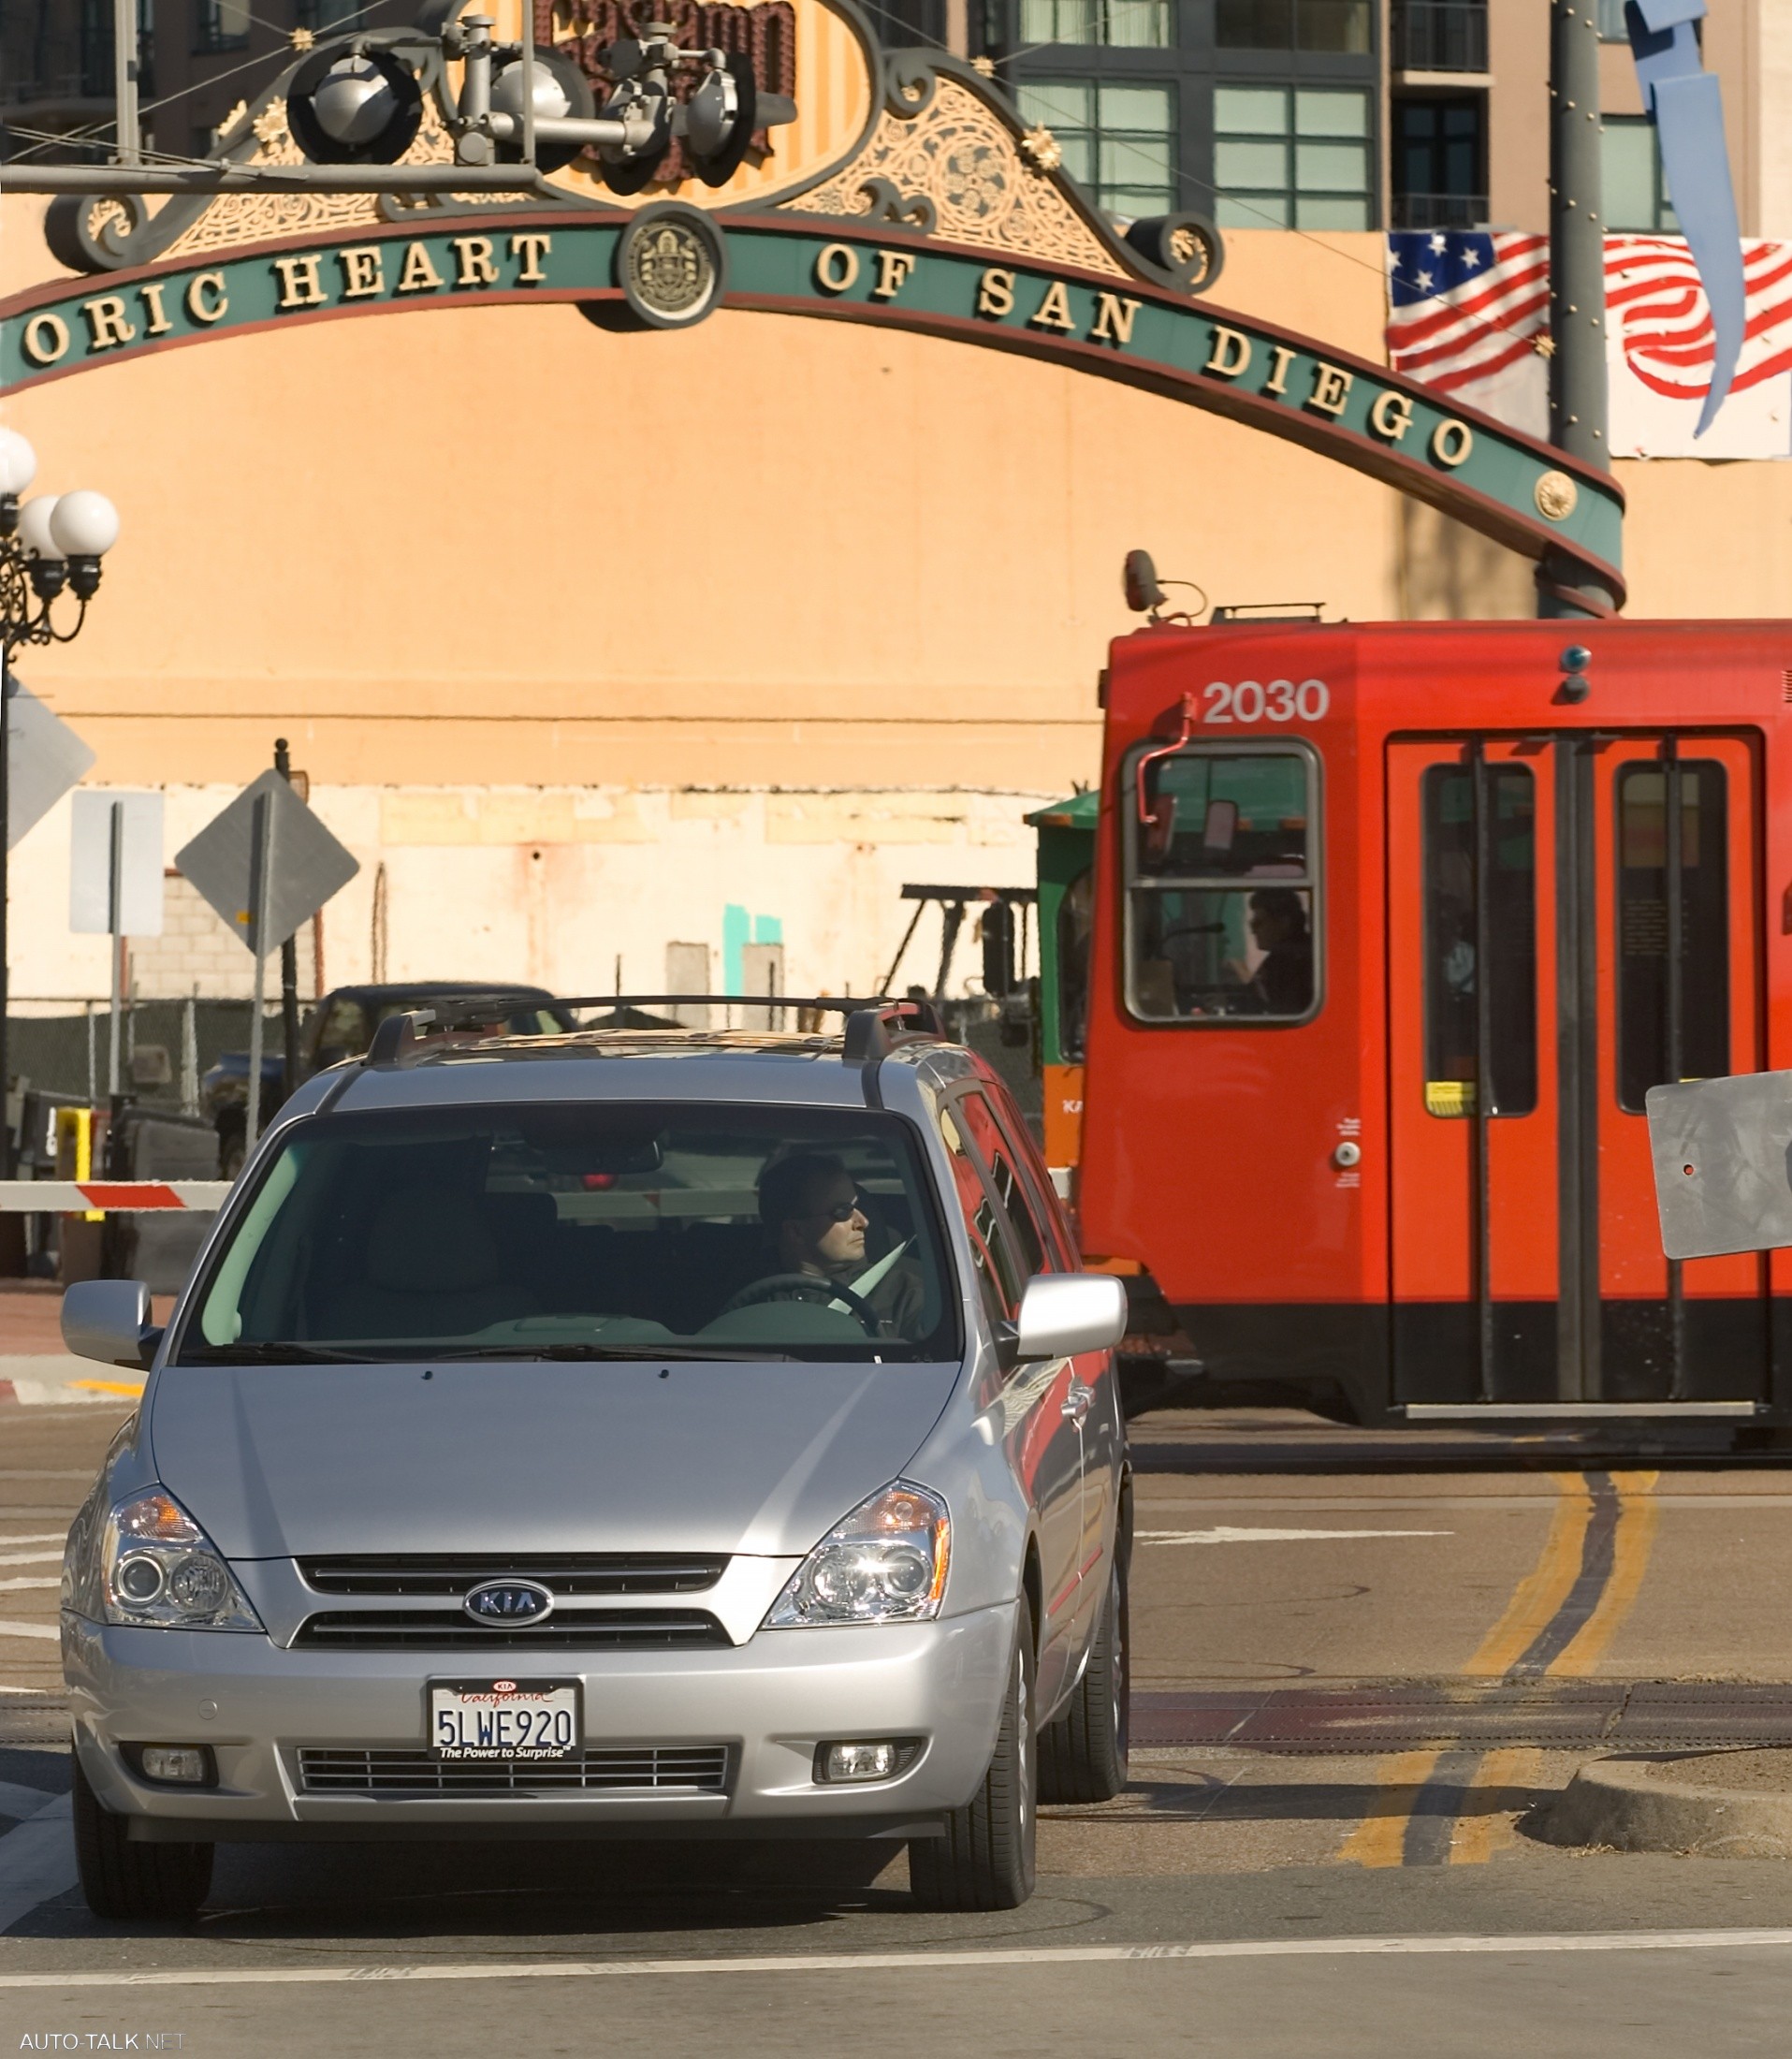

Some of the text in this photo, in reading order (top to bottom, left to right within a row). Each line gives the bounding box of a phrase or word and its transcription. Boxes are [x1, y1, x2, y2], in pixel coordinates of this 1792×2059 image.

[275, 234, 552, 308] HEART
[816, 242, 915, 297] OF
[979, 268, 1143, 343] SAN
[1205, 324, 1474, 466] DIEGO
[1203, 679, 1331, 723] 2030
[480, 1591, 537, 1613] KIA
[439, 1710, 572, 1746] 5LWE920
[440, 1747, 461, 1759] The
[462, 1747, 500, 1759] Power
[501, 1747, 514, 1759] to
